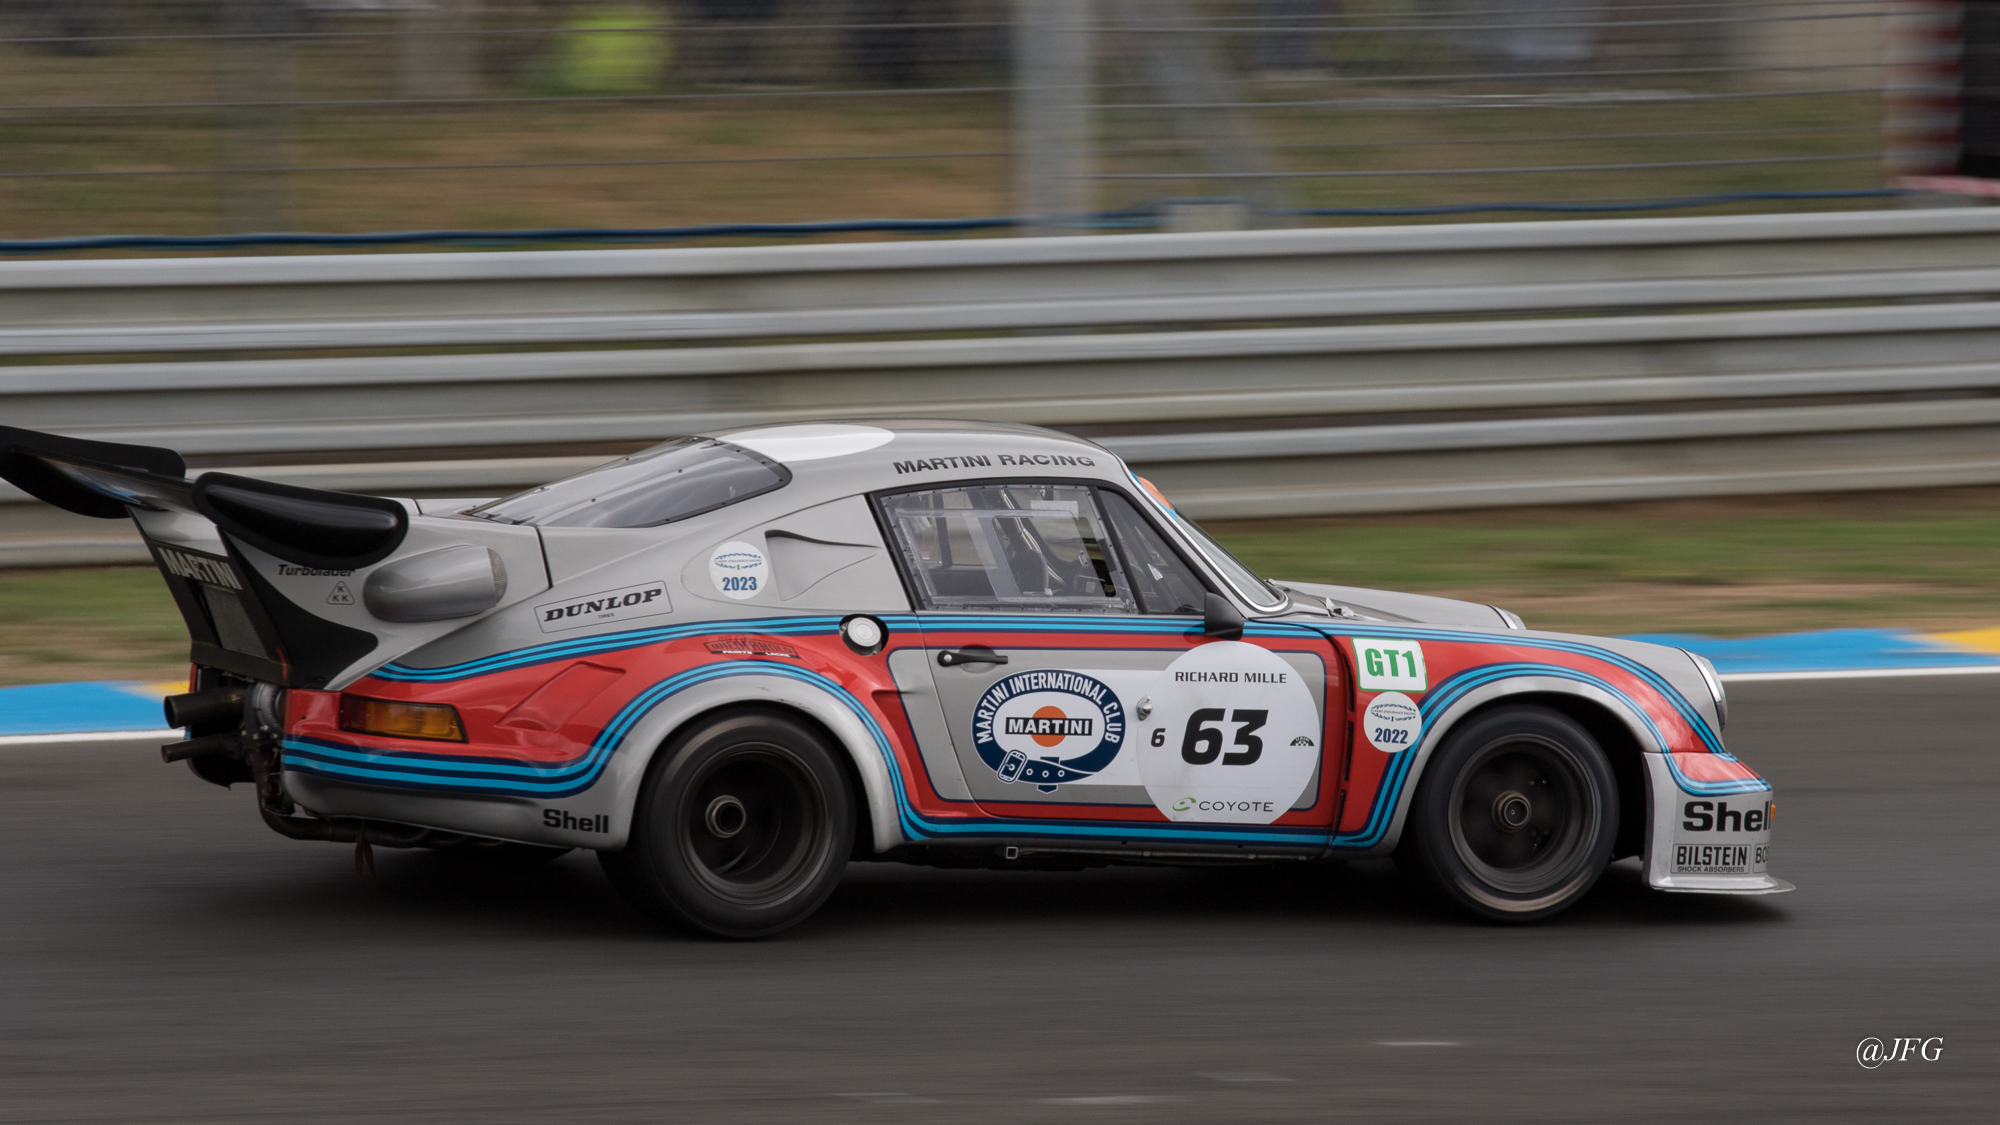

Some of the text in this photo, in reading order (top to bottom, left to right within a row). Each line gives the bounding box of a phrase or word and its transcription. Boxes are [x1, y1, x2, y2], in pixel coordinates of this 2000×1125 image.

[893, 454, 1096, 474] MARTINI RACING
[157, 547, 243, 591] MARTINI
[722, 576, 758, 591] 2023
[332, 594, 349, 602] K K
[544, 588, 662, 622] DUNLOP
[1364, 648, 1417, 678] GT1
[1175, 671, 1287, 684] RICHARD MILLE
[976, 672, 1122, 744] MARTINI INTERNATIONAL CLUB
[1008, 718, 1090, 735] MARTINI
[1374, 727, 1409, 744] 2022
[1150, 728, 1167, 748] 6
[1181, 708, 1269, 766] 63
[1198, 801, 1274, 812] COYOTE
[543, 808, 609, 834] Shell
[1676, 846, 1748, 866] BILSTEIN
[1677, 865, 1702, 873] SHOCK
